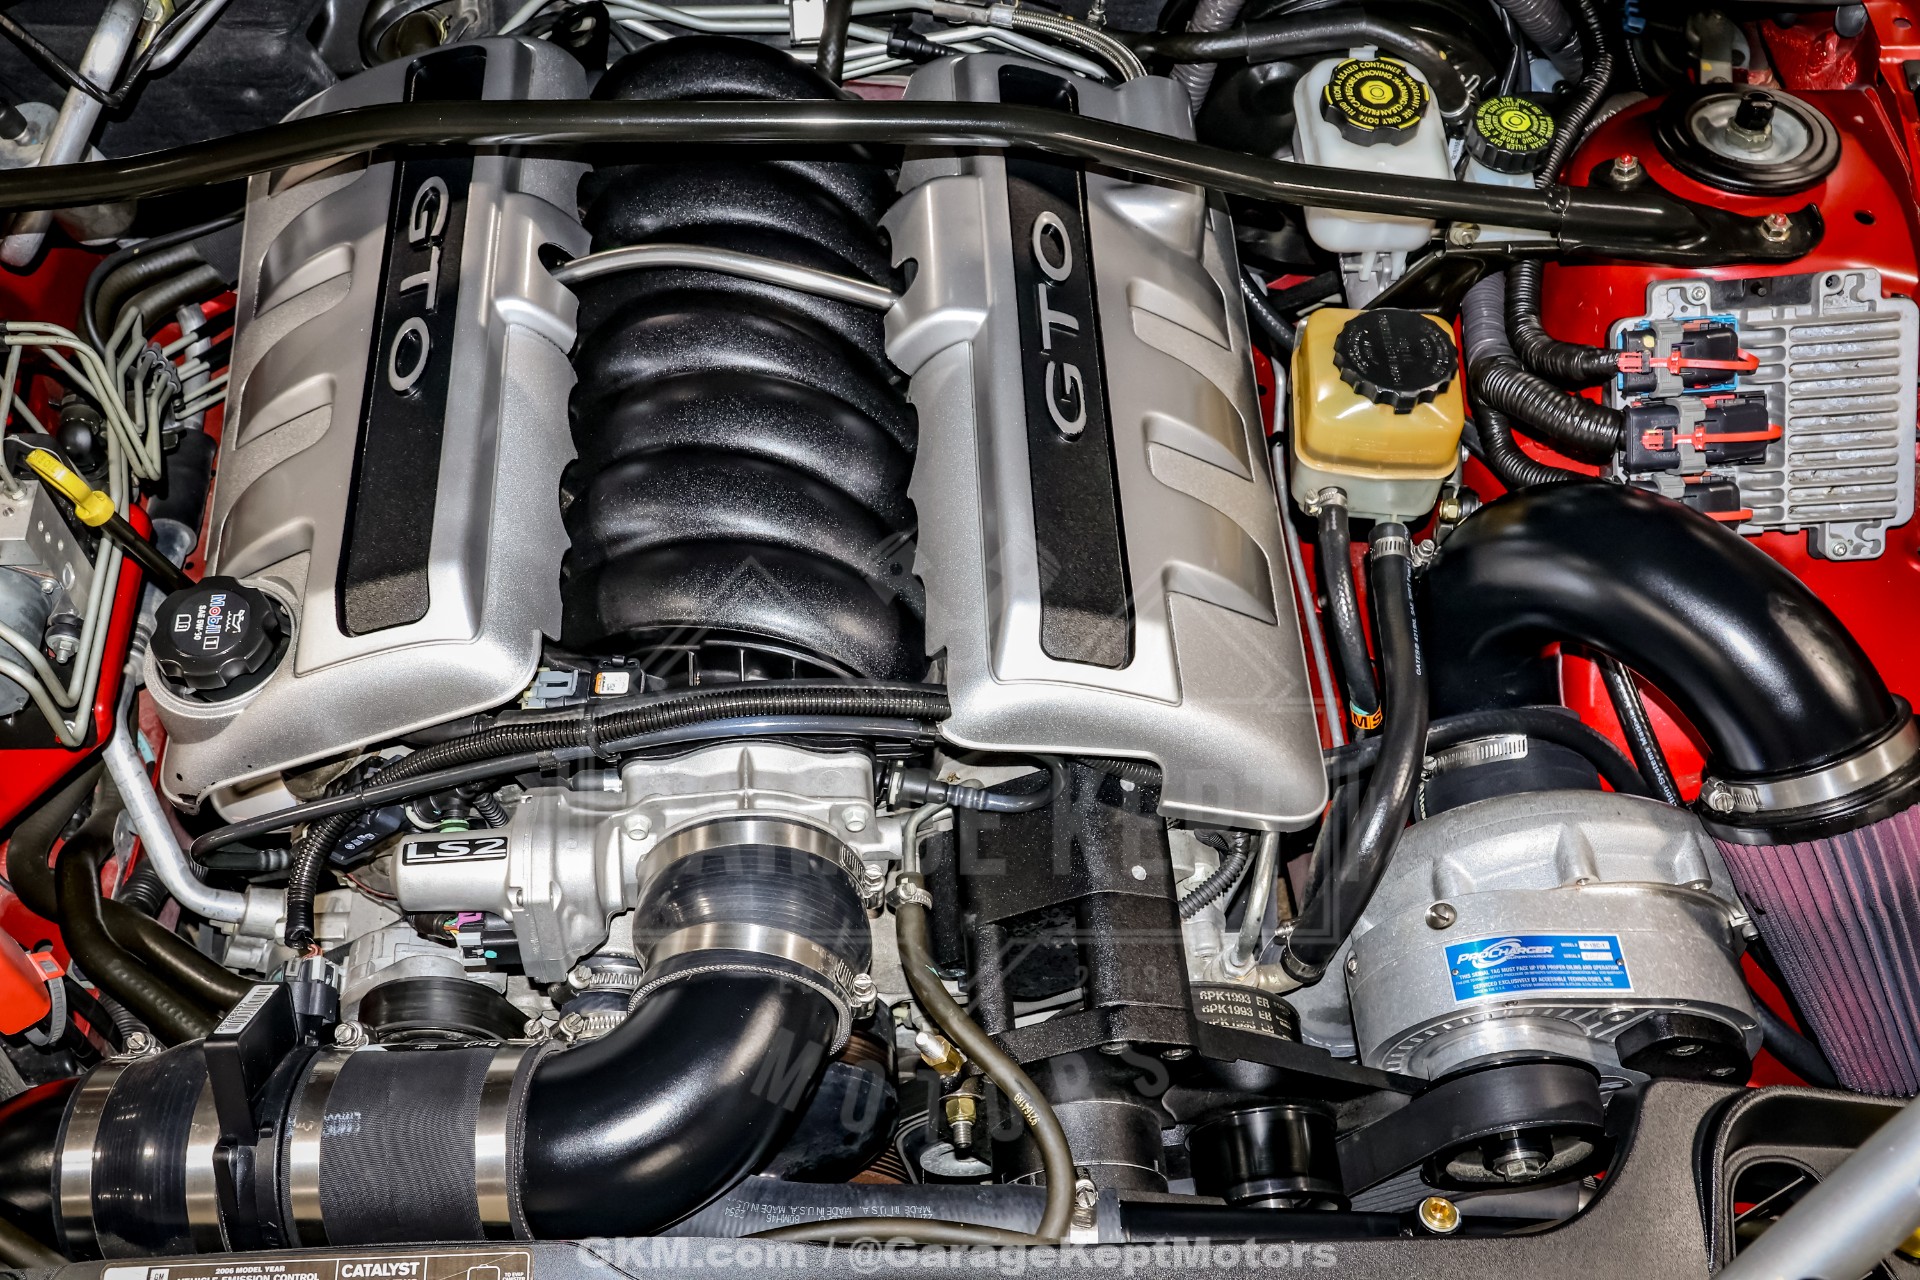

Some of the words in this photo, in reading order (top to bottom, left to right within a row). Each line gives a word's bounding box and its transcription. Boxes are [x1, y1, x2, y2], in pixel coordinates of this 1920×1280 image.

[1355, 70, 1392, 80] REMOVING
[1360, 62, 1401, 75] CONTAINER
[388, 176, 449, 392] GTO
[1032, 211, 1087, 435] GTO
[198, 605, 206, 619] SAE
[205, 594, 226, 634] Mobil
[194, 619, 204, 640] 5W-30
[1634, 715, 1647, 746] Made
[1645, 746, 1669, 786] Systems
[406, 838, 506, 860] LS2
[1014, 1092, 1040, 1126] 92164189
[762, 1204, 786, 1214] MADE
[826, 1206, 852, 1215] MADE
[341, 1262, 420, 1278] CATALYST
